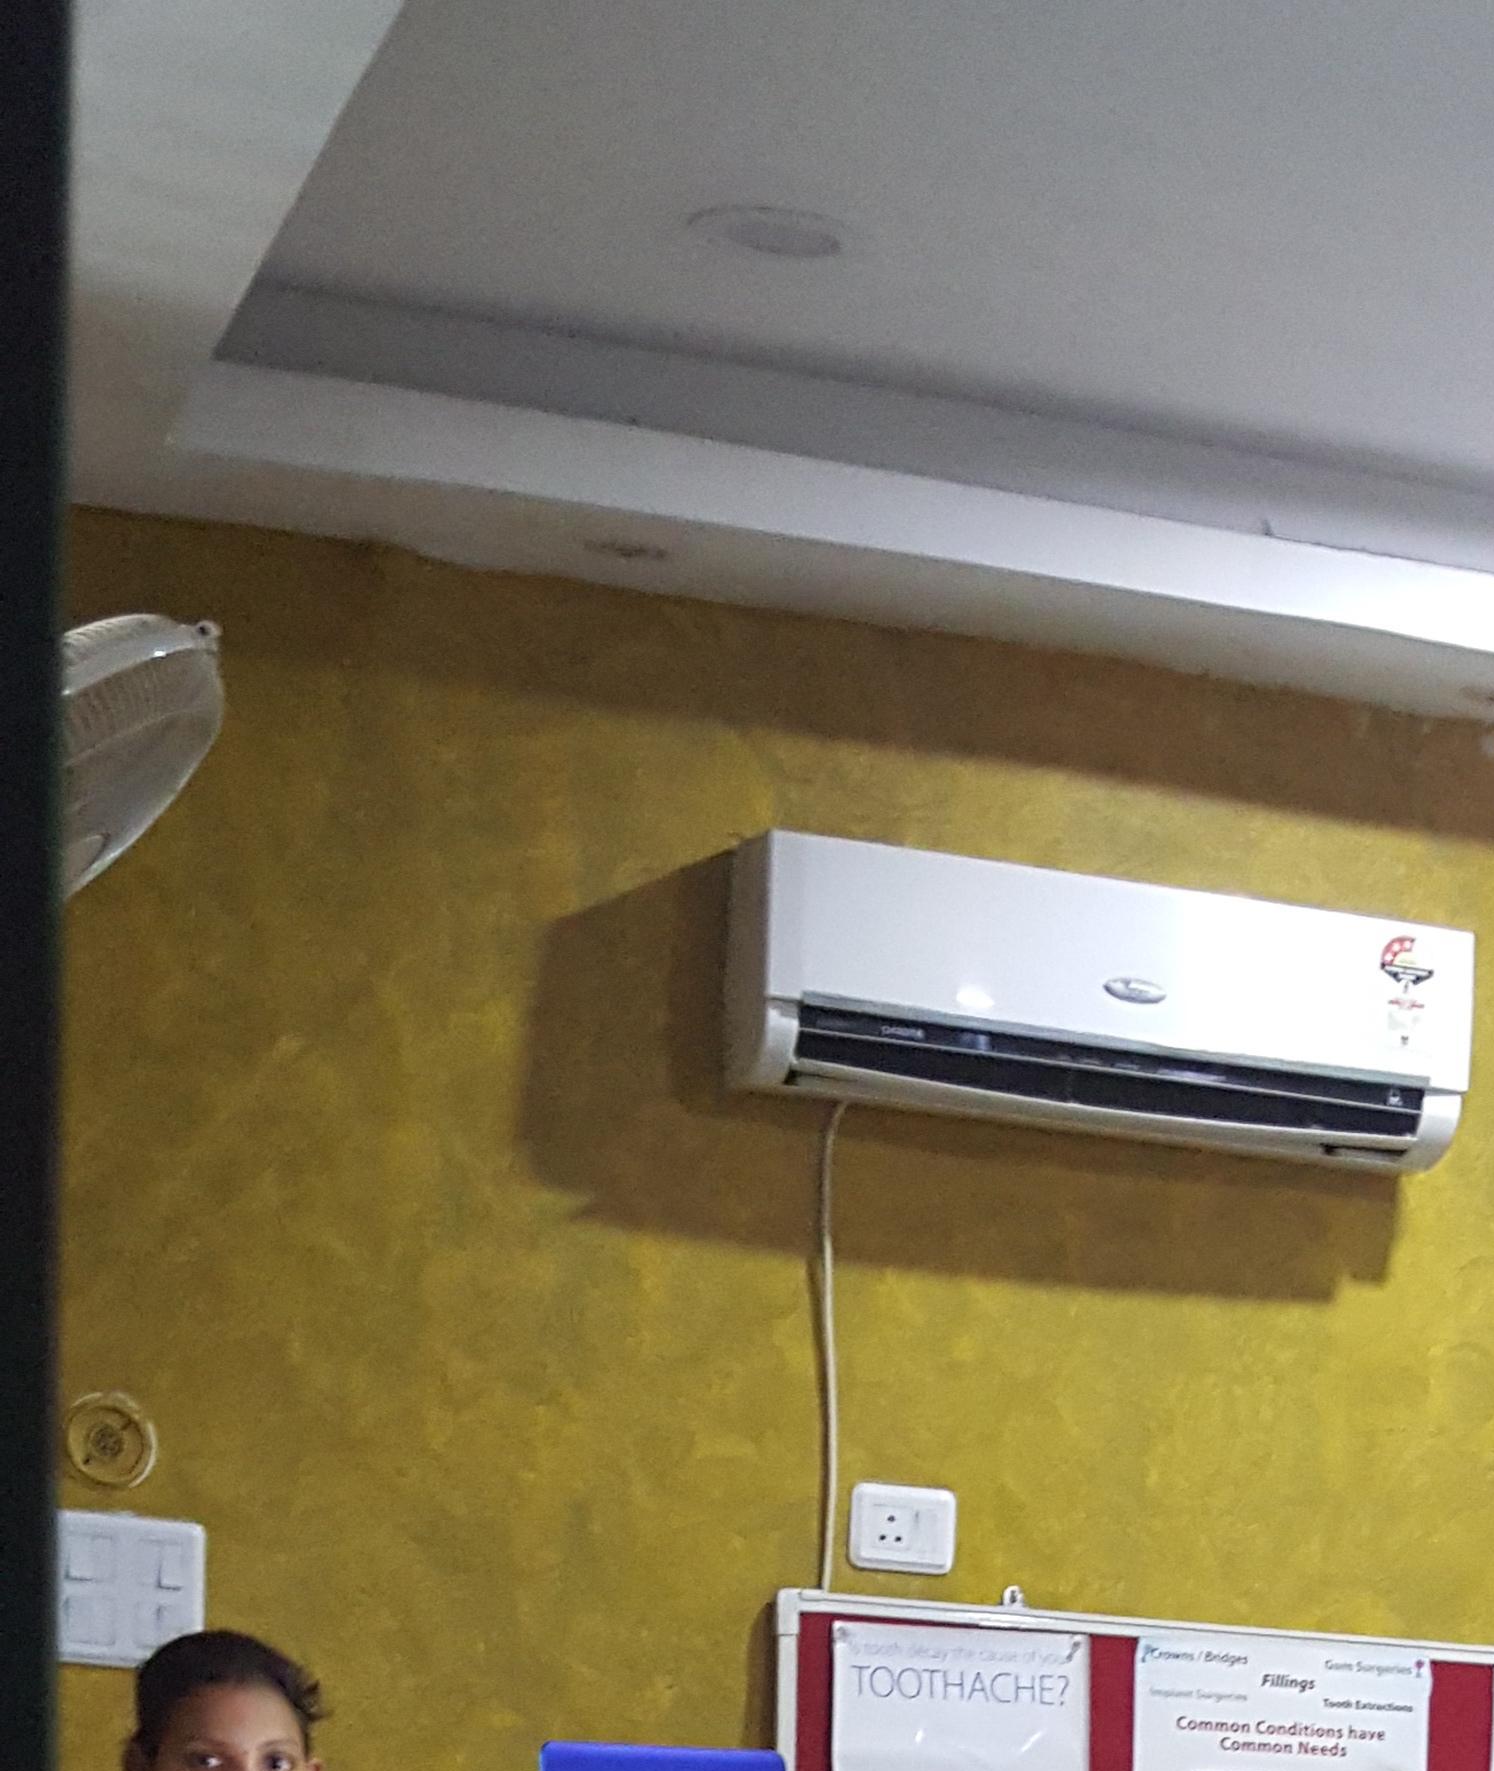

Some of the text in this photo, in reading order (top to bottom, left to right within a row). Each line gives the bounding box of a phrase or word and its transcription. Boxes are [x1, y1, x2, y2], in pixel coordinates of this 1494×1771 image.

[1205, 1651, 1249, 1667] Bridges
[850, 1665, 1070, 1706] TOOTHACHE?
[1260, 1673, 1316, 1693] Fillings
[1175, 1715, 1386, 1742] Common Conditions have
[1219, 1736, 1348, 1758] Common Needs
